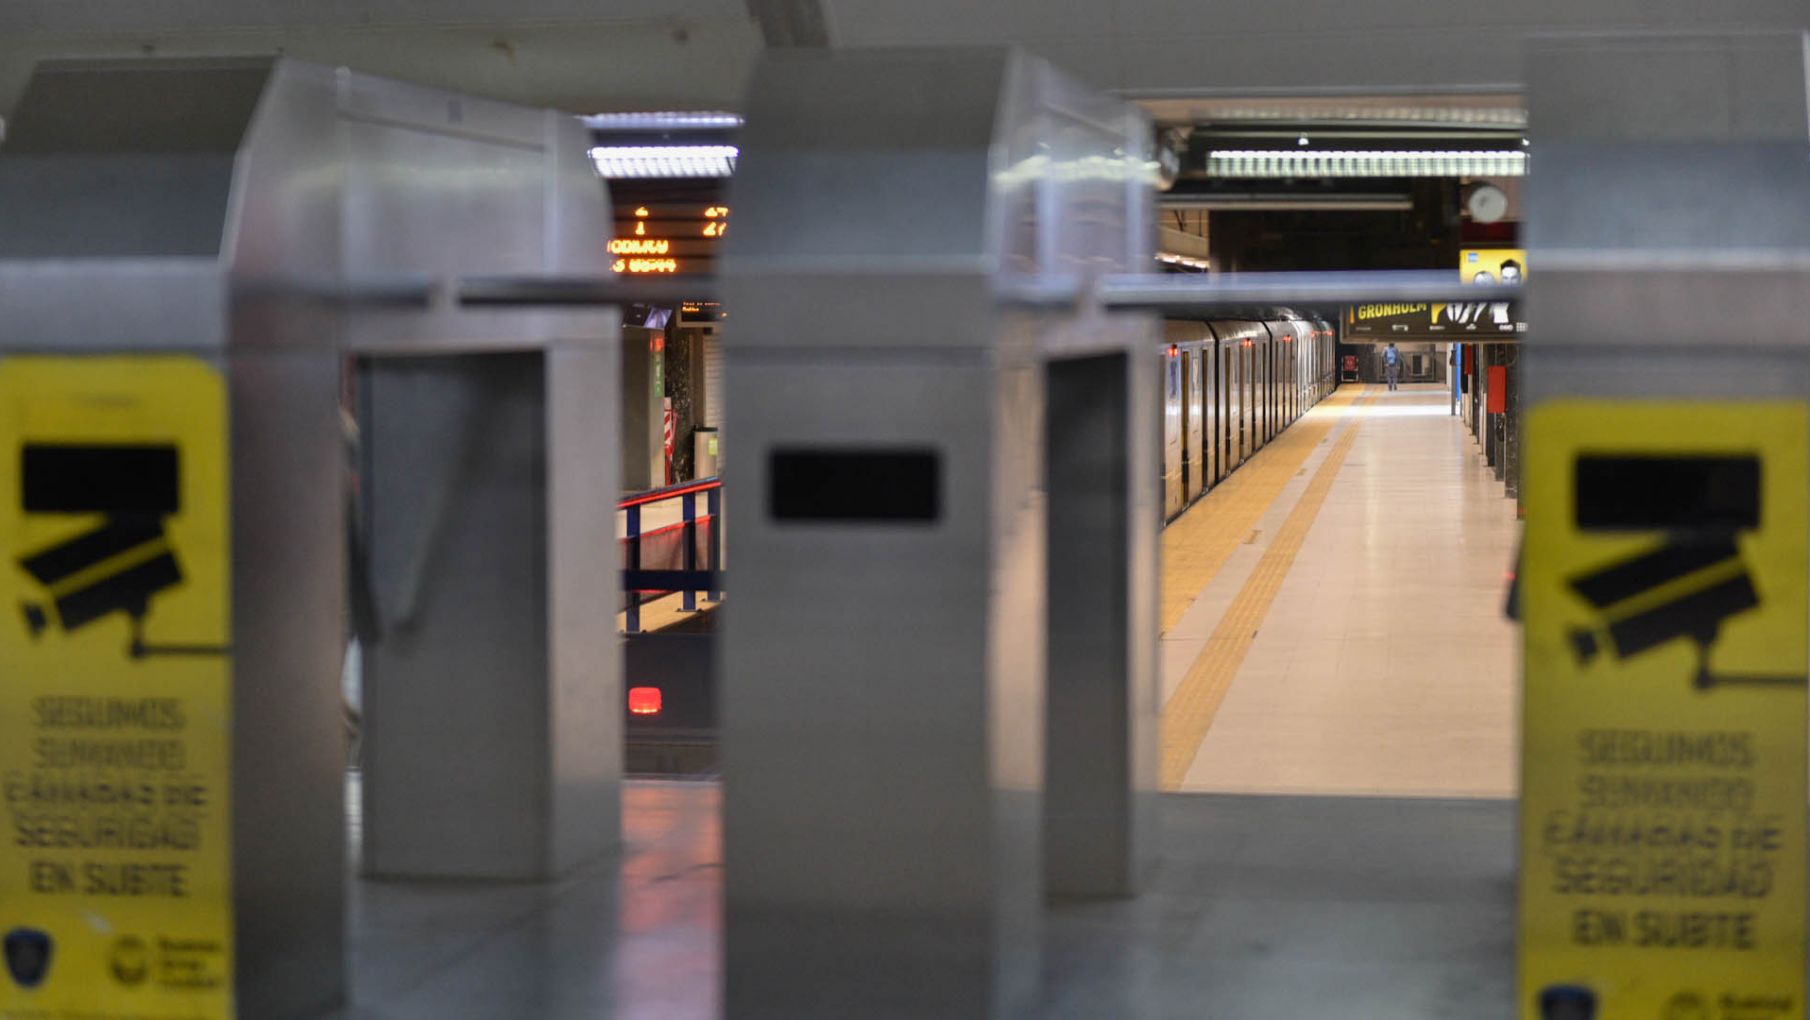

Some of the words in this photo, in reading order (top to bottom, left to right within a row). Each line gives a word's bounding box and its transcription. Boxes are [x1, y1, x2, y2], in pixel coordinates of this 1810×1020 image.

[32, 696, 187, 729] SEGUIMOS
[32, 737, 187, 770] SUMANDO
[1578, 729, 1756, 768] SEGUIMOS
[1578, 774, 1755, 811] SUMANDO
[15, 816, 201, 850] SEGURIDAD
[29, 861, 75, 895] EN
[82, 863, 190, 898] SUBTE
[1554, 857, 1775, 898] SEGURIDAD
[1572, 909, 1628, 948] EN
[1633, 910, 1758, 951] SUBTE
